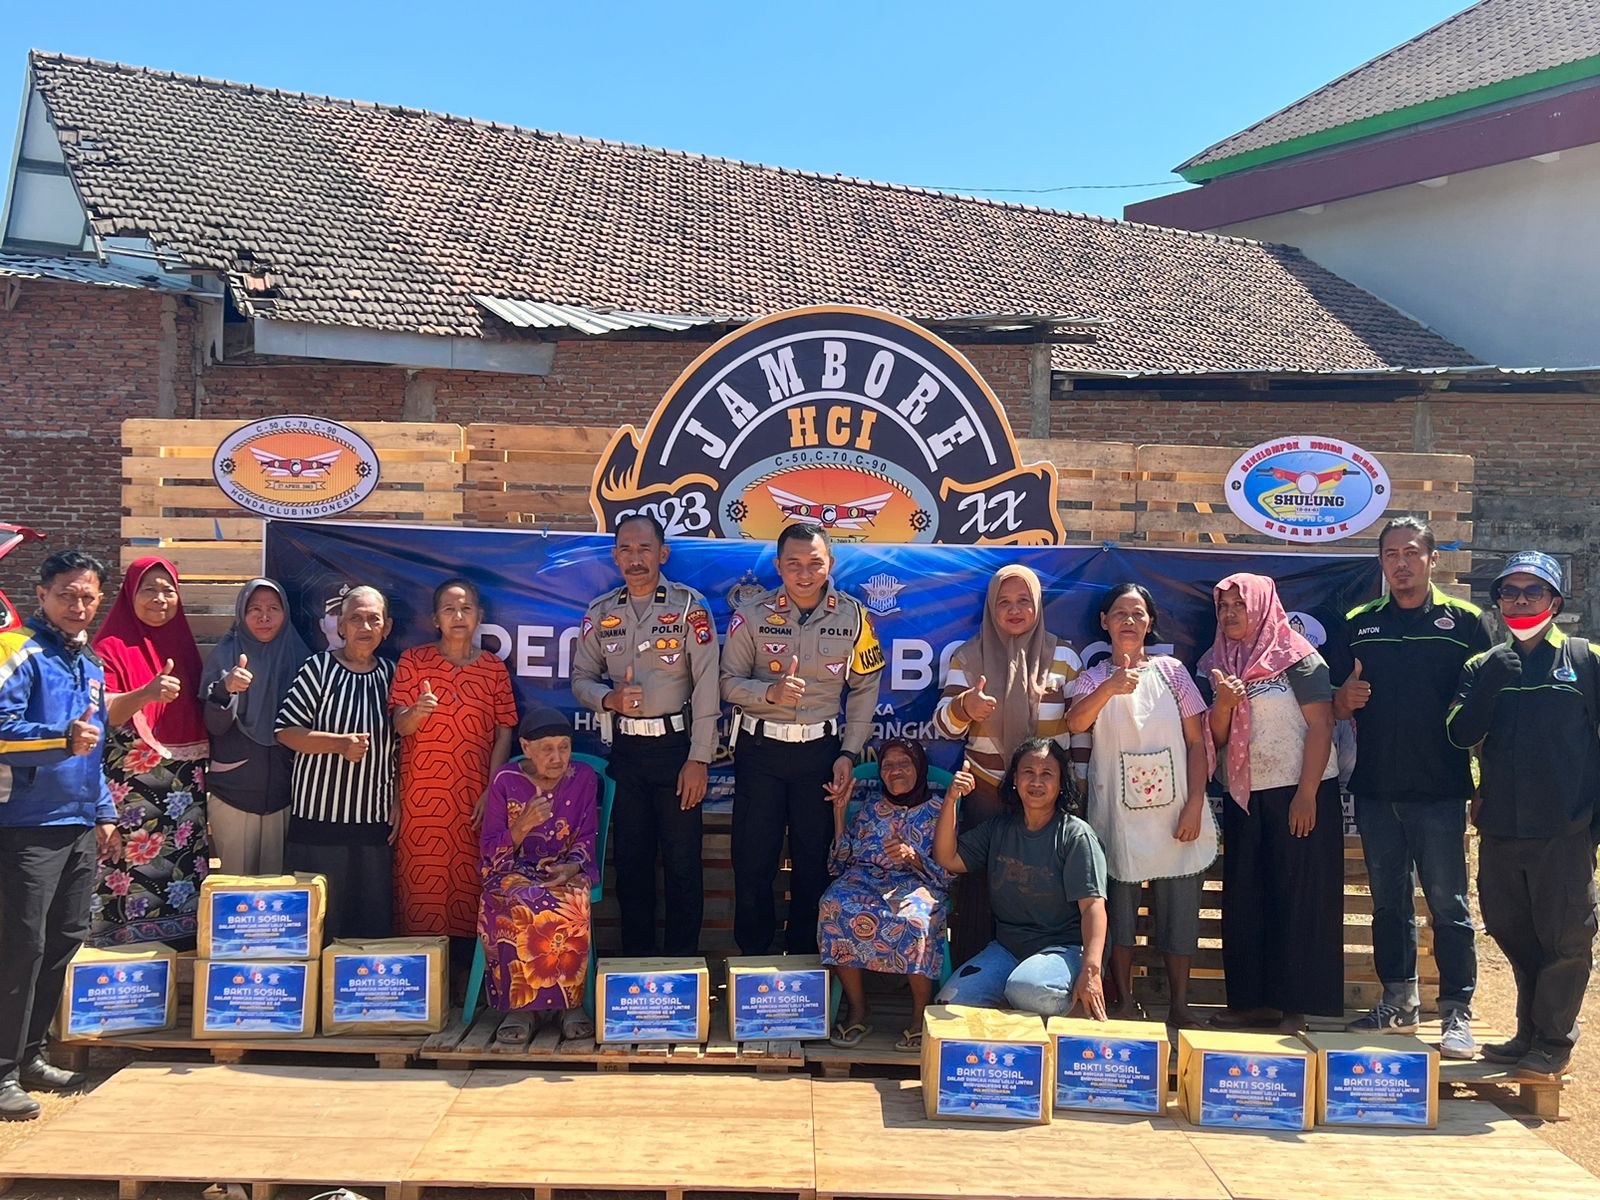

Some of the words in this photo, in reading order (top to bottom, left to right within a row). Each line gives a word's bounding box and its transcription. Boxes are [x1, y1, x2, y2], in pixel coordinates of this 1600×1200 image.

[685, 340, 976, 460] JAMBORE
[788, 406, 877, 451] HCI
[231, 488, 266, 510] HONDA
[268, 506, 298, 516] CLUB
[301, 492, 361, 516] INDONESIA
[1274, 494, 1344, 506] SHULUNG
[957, 490, 1026, 534] XX
[1264, 520, 1349, 536] NGANJUK
[652, 624, 683, 634] POLRI
[758, 626, 792, 636] ROCHAN
[820, 627, 853, 637] POLRI
[1358, 626, 1380, 636] ANTON
[118, 986, 151, 994] SOSIAL
[957, 1068, 985, 1077] BAKTI
[988, 1070, 1024, 1079] SOSIAL
[1074, 1063, 1102, 1071] BAKTI
[1105, 1065, 1140, 1074] SOSIAL
[1219, 1080, 1247, 1089] BAKTI
[1251, 1082, 1287, 1091] SOSIAL
[1375, 1079, 1410, 1087] SOSIAL
